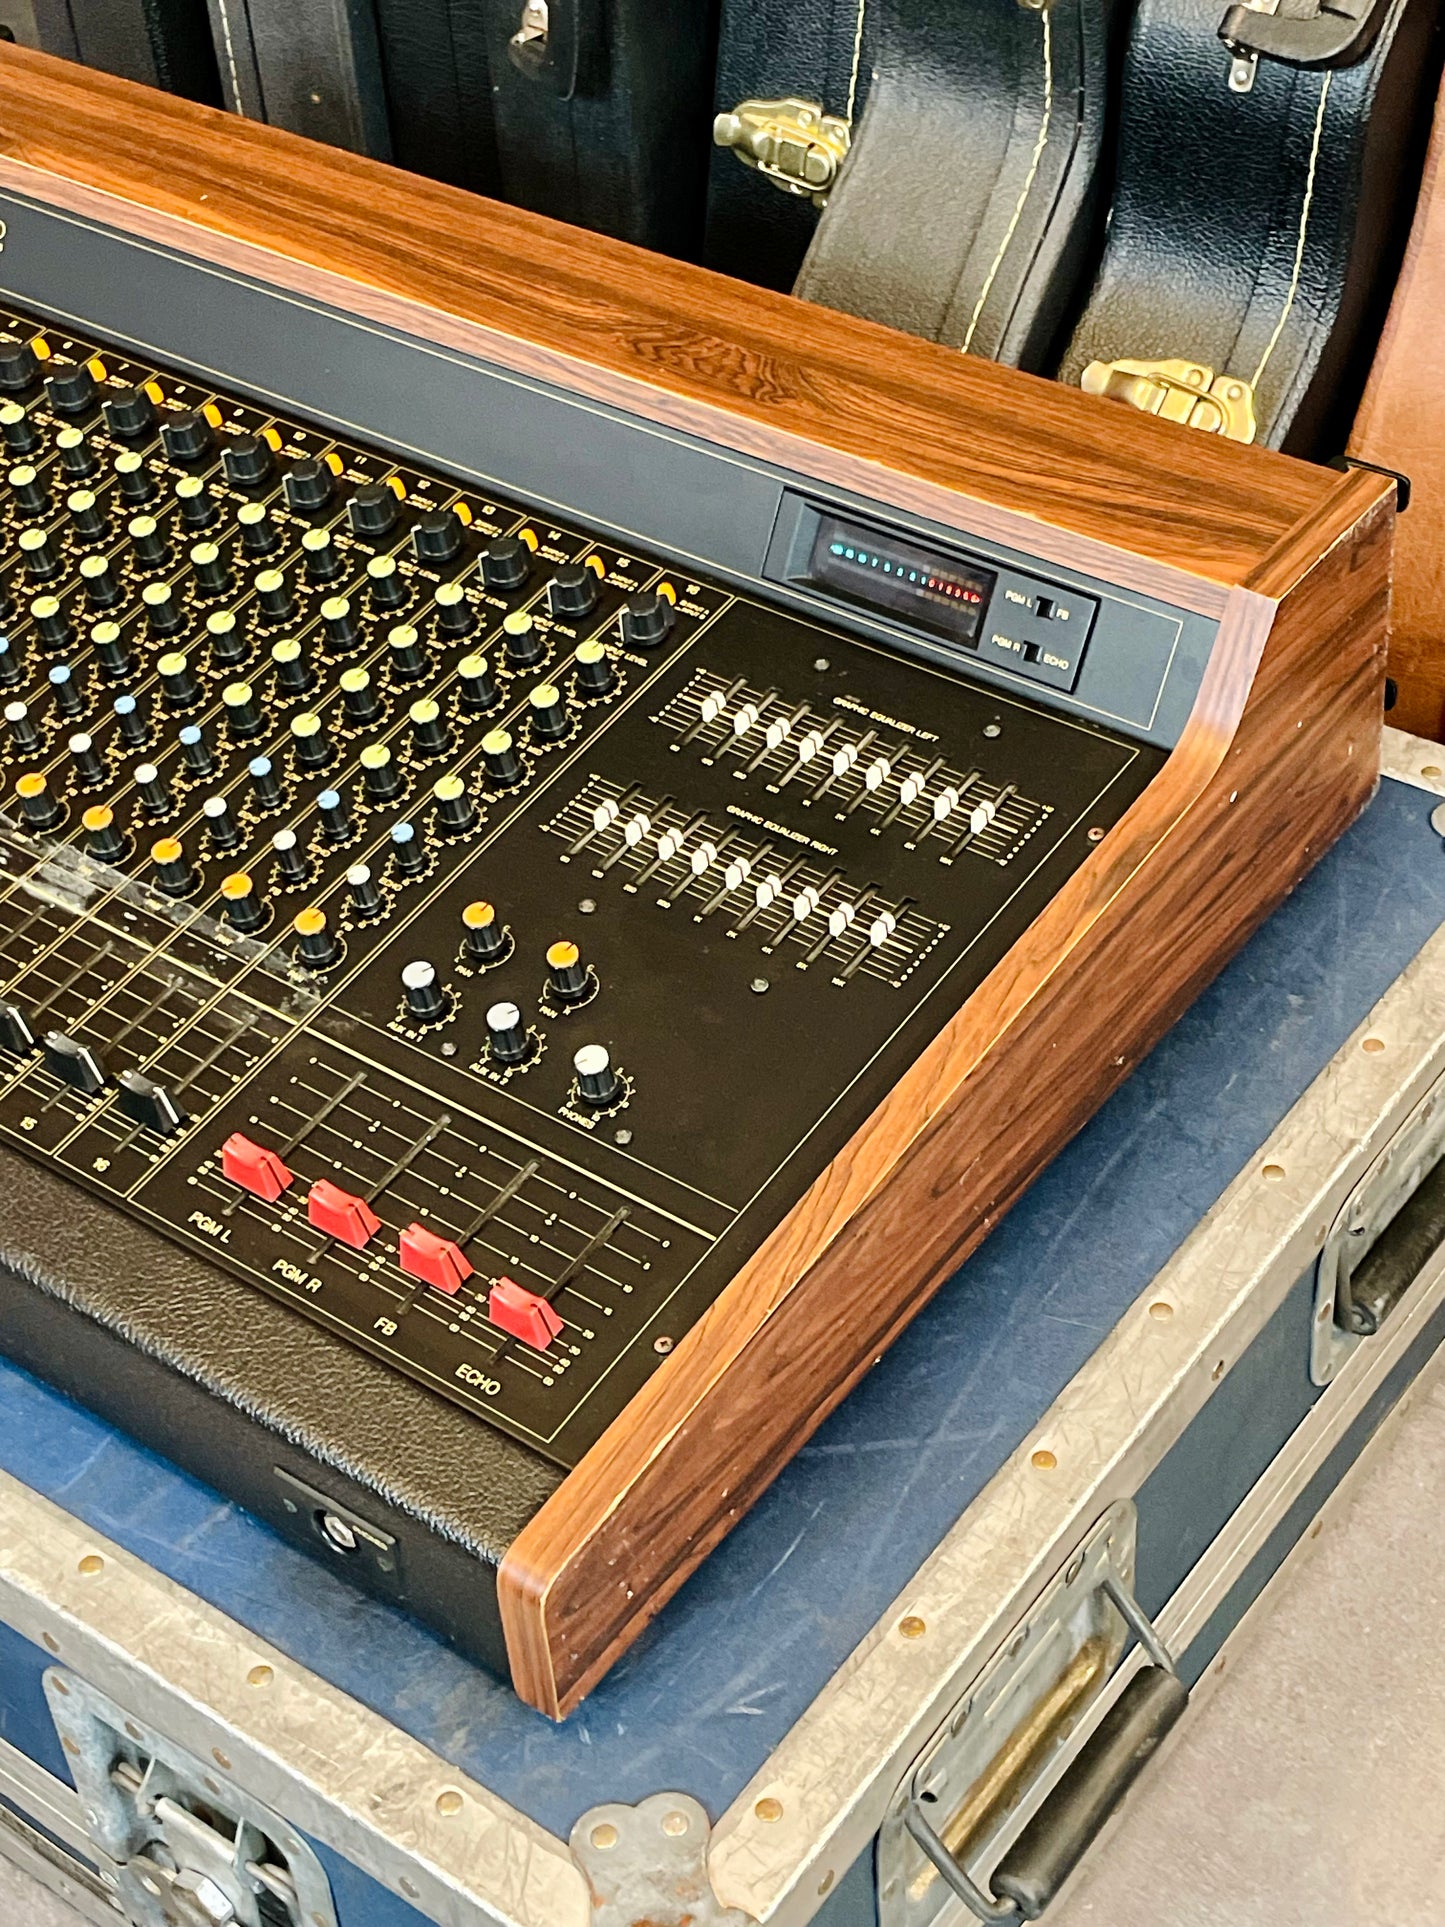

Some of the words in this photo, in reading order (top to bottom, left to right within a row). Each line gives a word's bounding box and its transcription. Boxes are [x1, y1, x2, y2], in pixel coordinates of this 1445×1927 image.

[1005, 589, 1026, 605] PGM
[1056, 608, 1070, 620] FB
[991, 633, 1012, 649] PGM
[1012, 642, 1021, 652] R
[1043, 653, 1069, 670] ECHO
[833, 695, 870, 716] GRAPHIC
[869, 711, 916, 734] EQUALIZER
[916, 730, 939, 742] LEFT
[726, 805, 764, 824] GRAPHIC
[763, 820, 810, 844] EQUALIZER
[810, 840, 838, 855] RIGHT
[454, 965, 474, 978] PAN
[539, 1006, 558, 1018] PAN
[386, 1021, 406, 1034] AUX
[405, 1030, 418, 1040] IN
[469, 1062, 490, 1076] AUX
[488, 1072, 501, 1082] IN
[20, 1116, 38, 1130] 15
[558, 1106, 596, 1130] PHONES
[92, 1158, 110, 1172] 16
[187, 1210, 222, 1238] PGM
[220, 1229, 231, 1244] L
[272, 1259, 309, 1285] PGM
[306, 1278, 322, 1293] R
[374, 1317, 398, 1336] FB
[455, 1363, 500, 1395] ECHO
